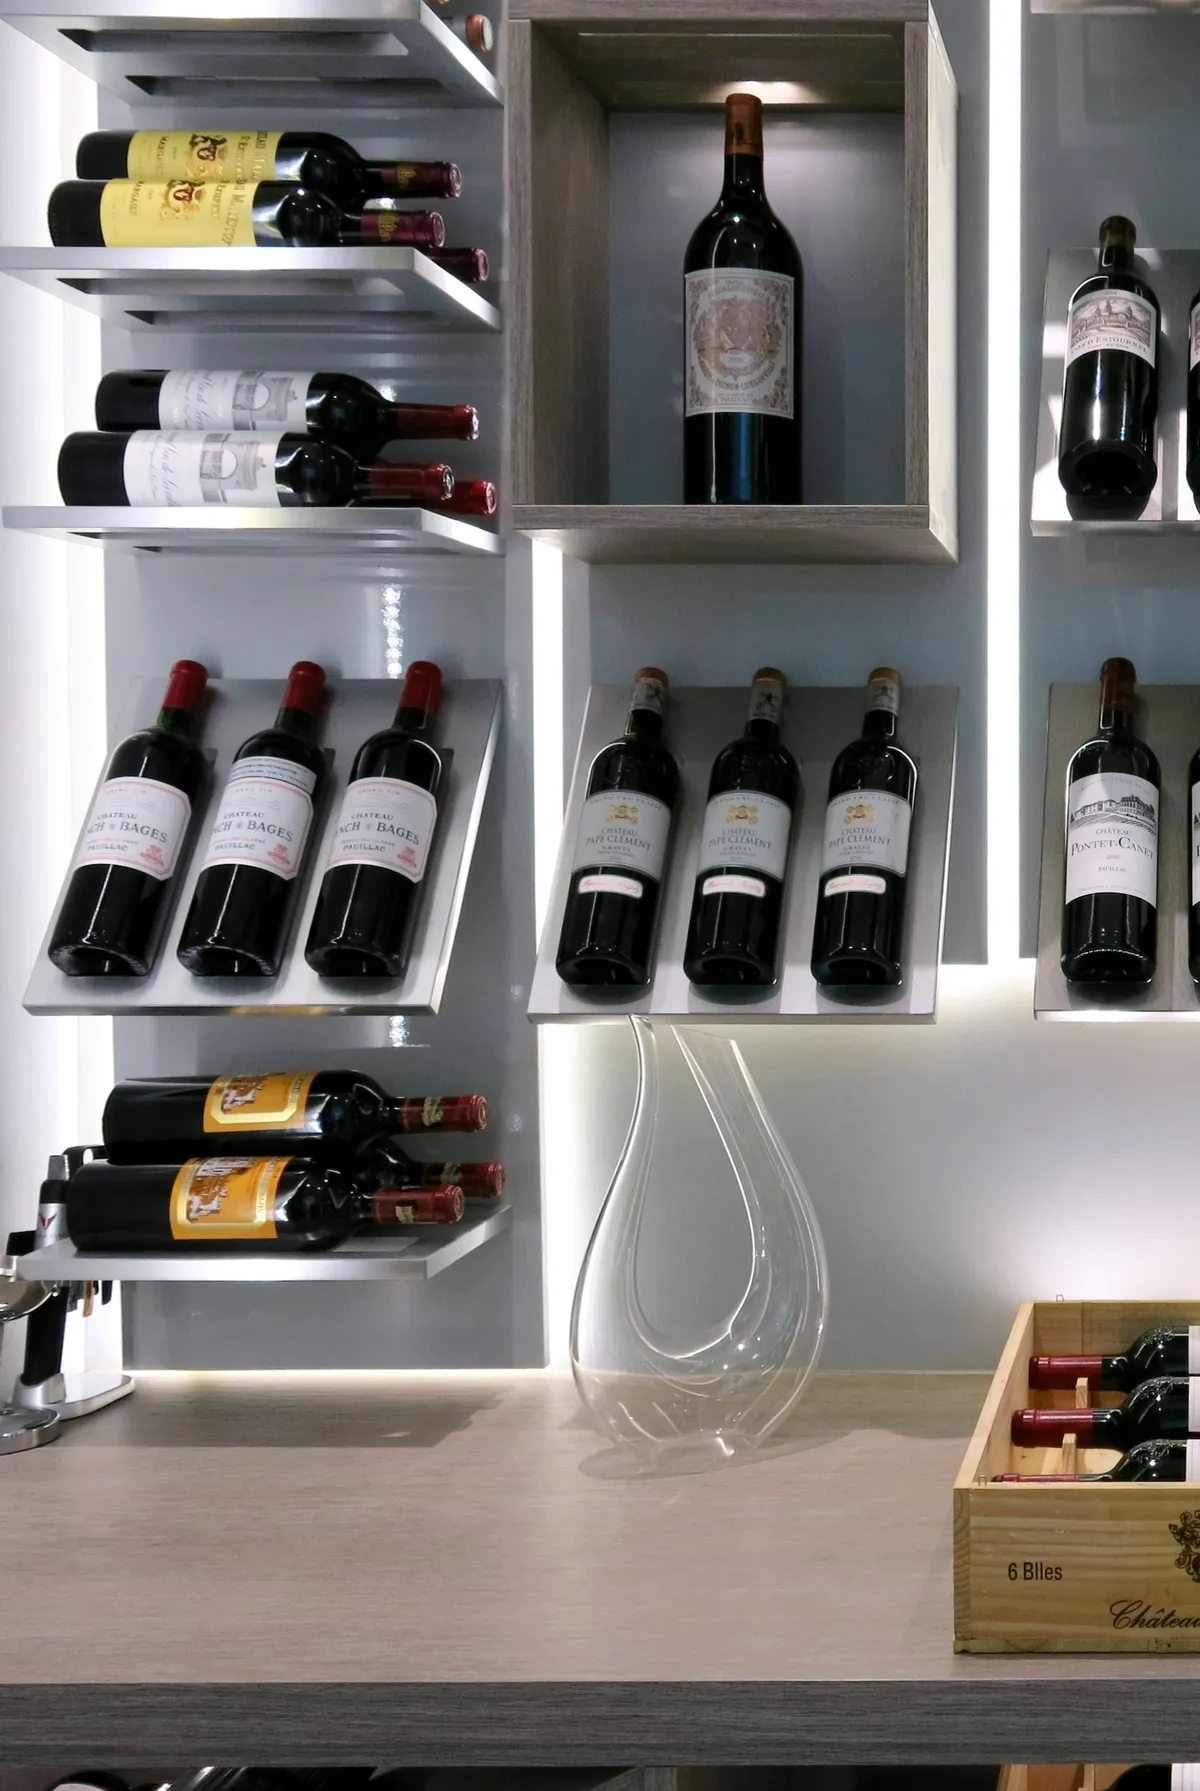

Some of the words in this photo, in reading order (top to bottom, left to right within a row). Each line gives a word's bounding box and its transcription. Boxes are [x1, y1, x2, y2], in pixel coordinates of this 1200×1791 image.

[119, 820, 169, 844] BAGES
[247, 820, 295, 842] BAGES
[376, 821, 421, 846] BAGES
[1008, 1562, 1018, 1581] 6
